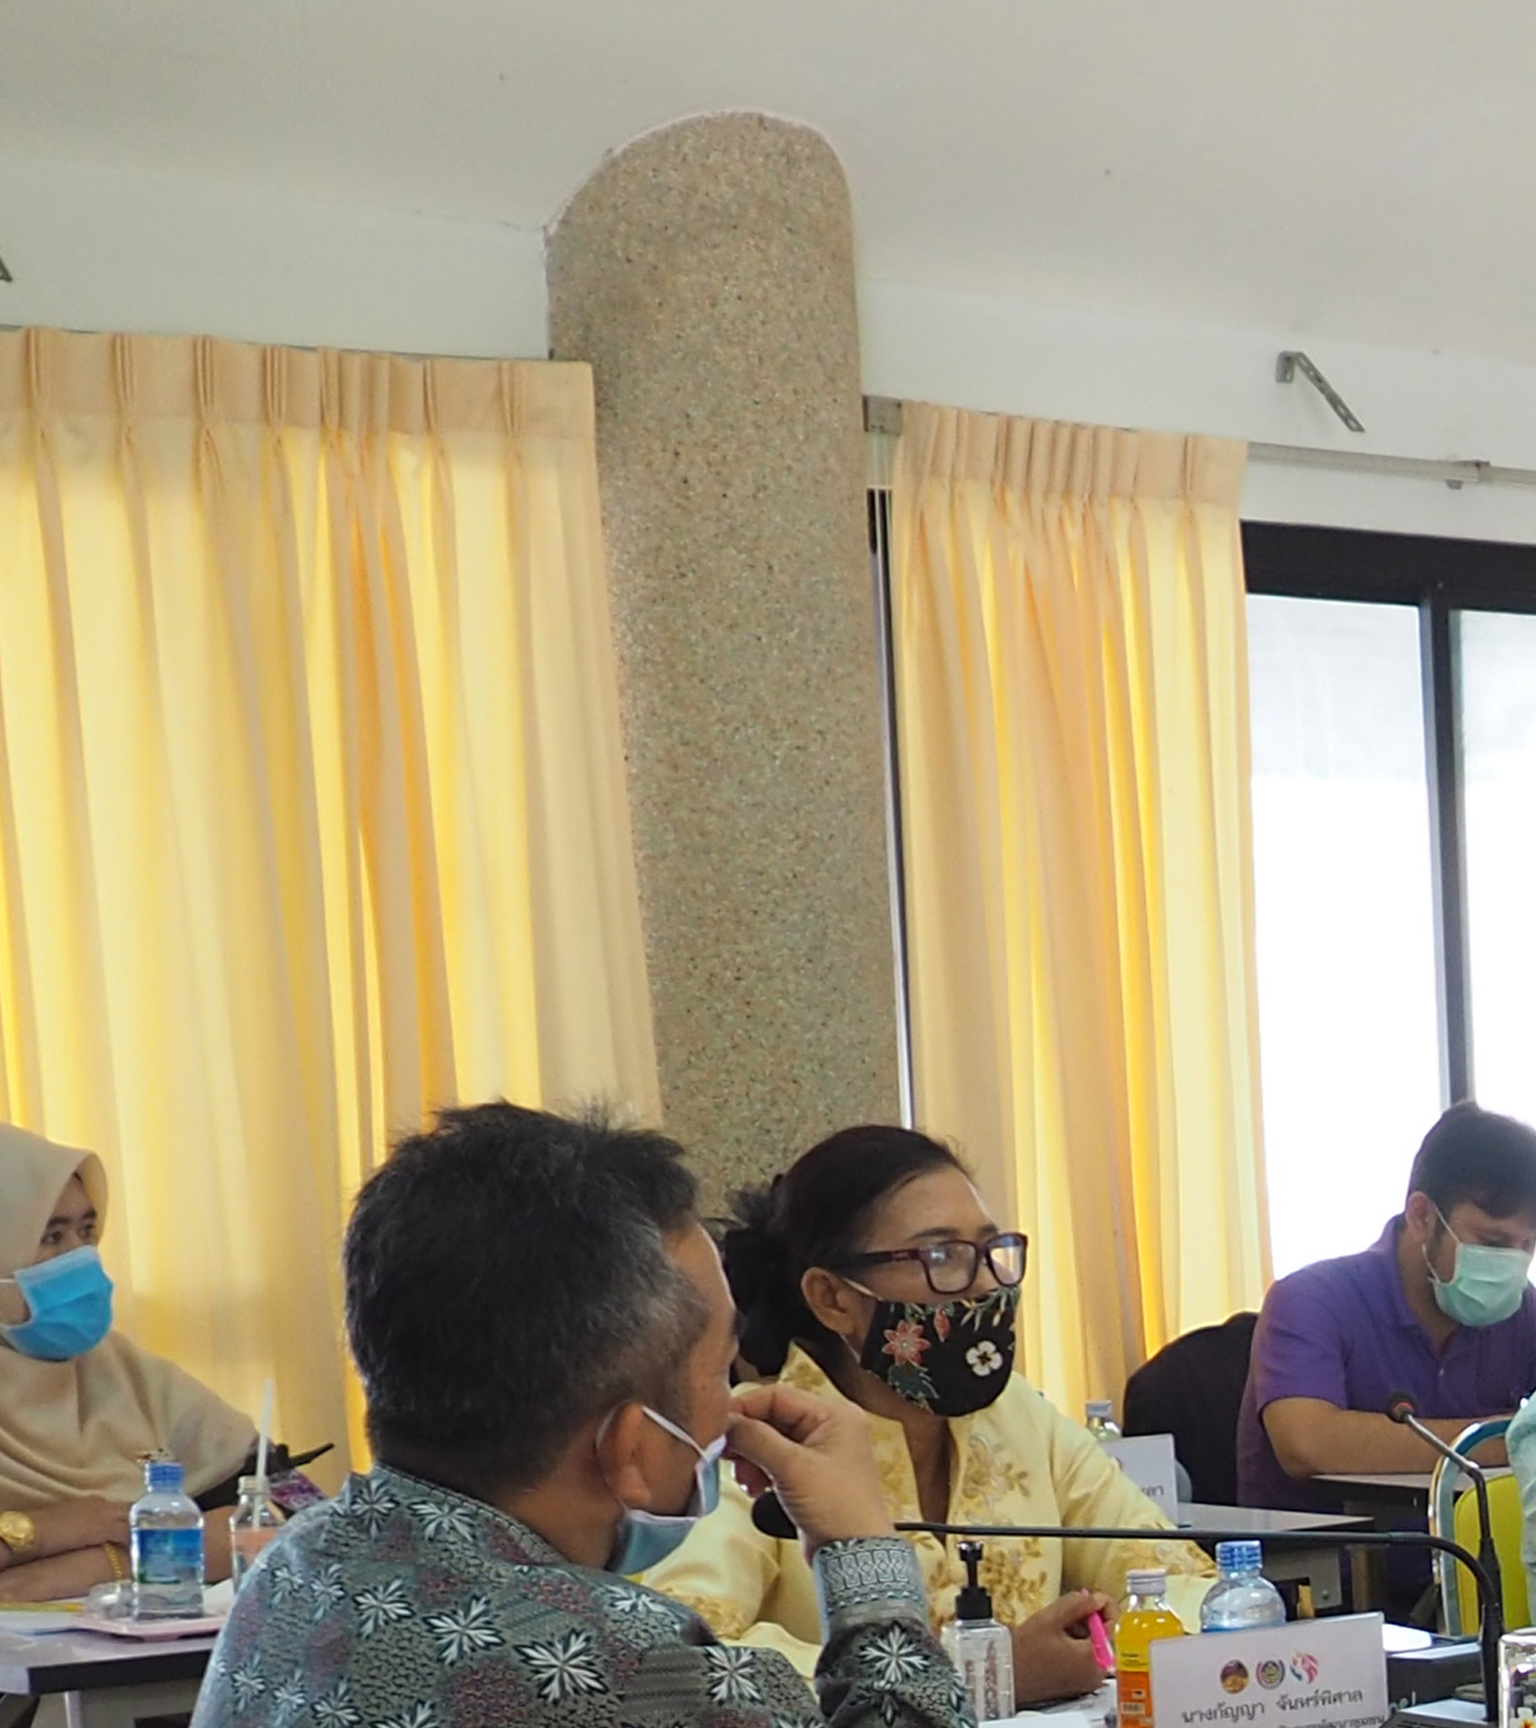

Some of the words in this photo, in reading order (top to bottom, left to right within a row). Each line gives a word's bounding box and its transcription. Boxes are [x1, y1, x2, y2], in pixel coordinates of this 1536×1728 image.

[1181, 1701, 1265, 1724] นางกัญญา
[1275, 1688, 1364, 1712] จันทร์พิศาล
